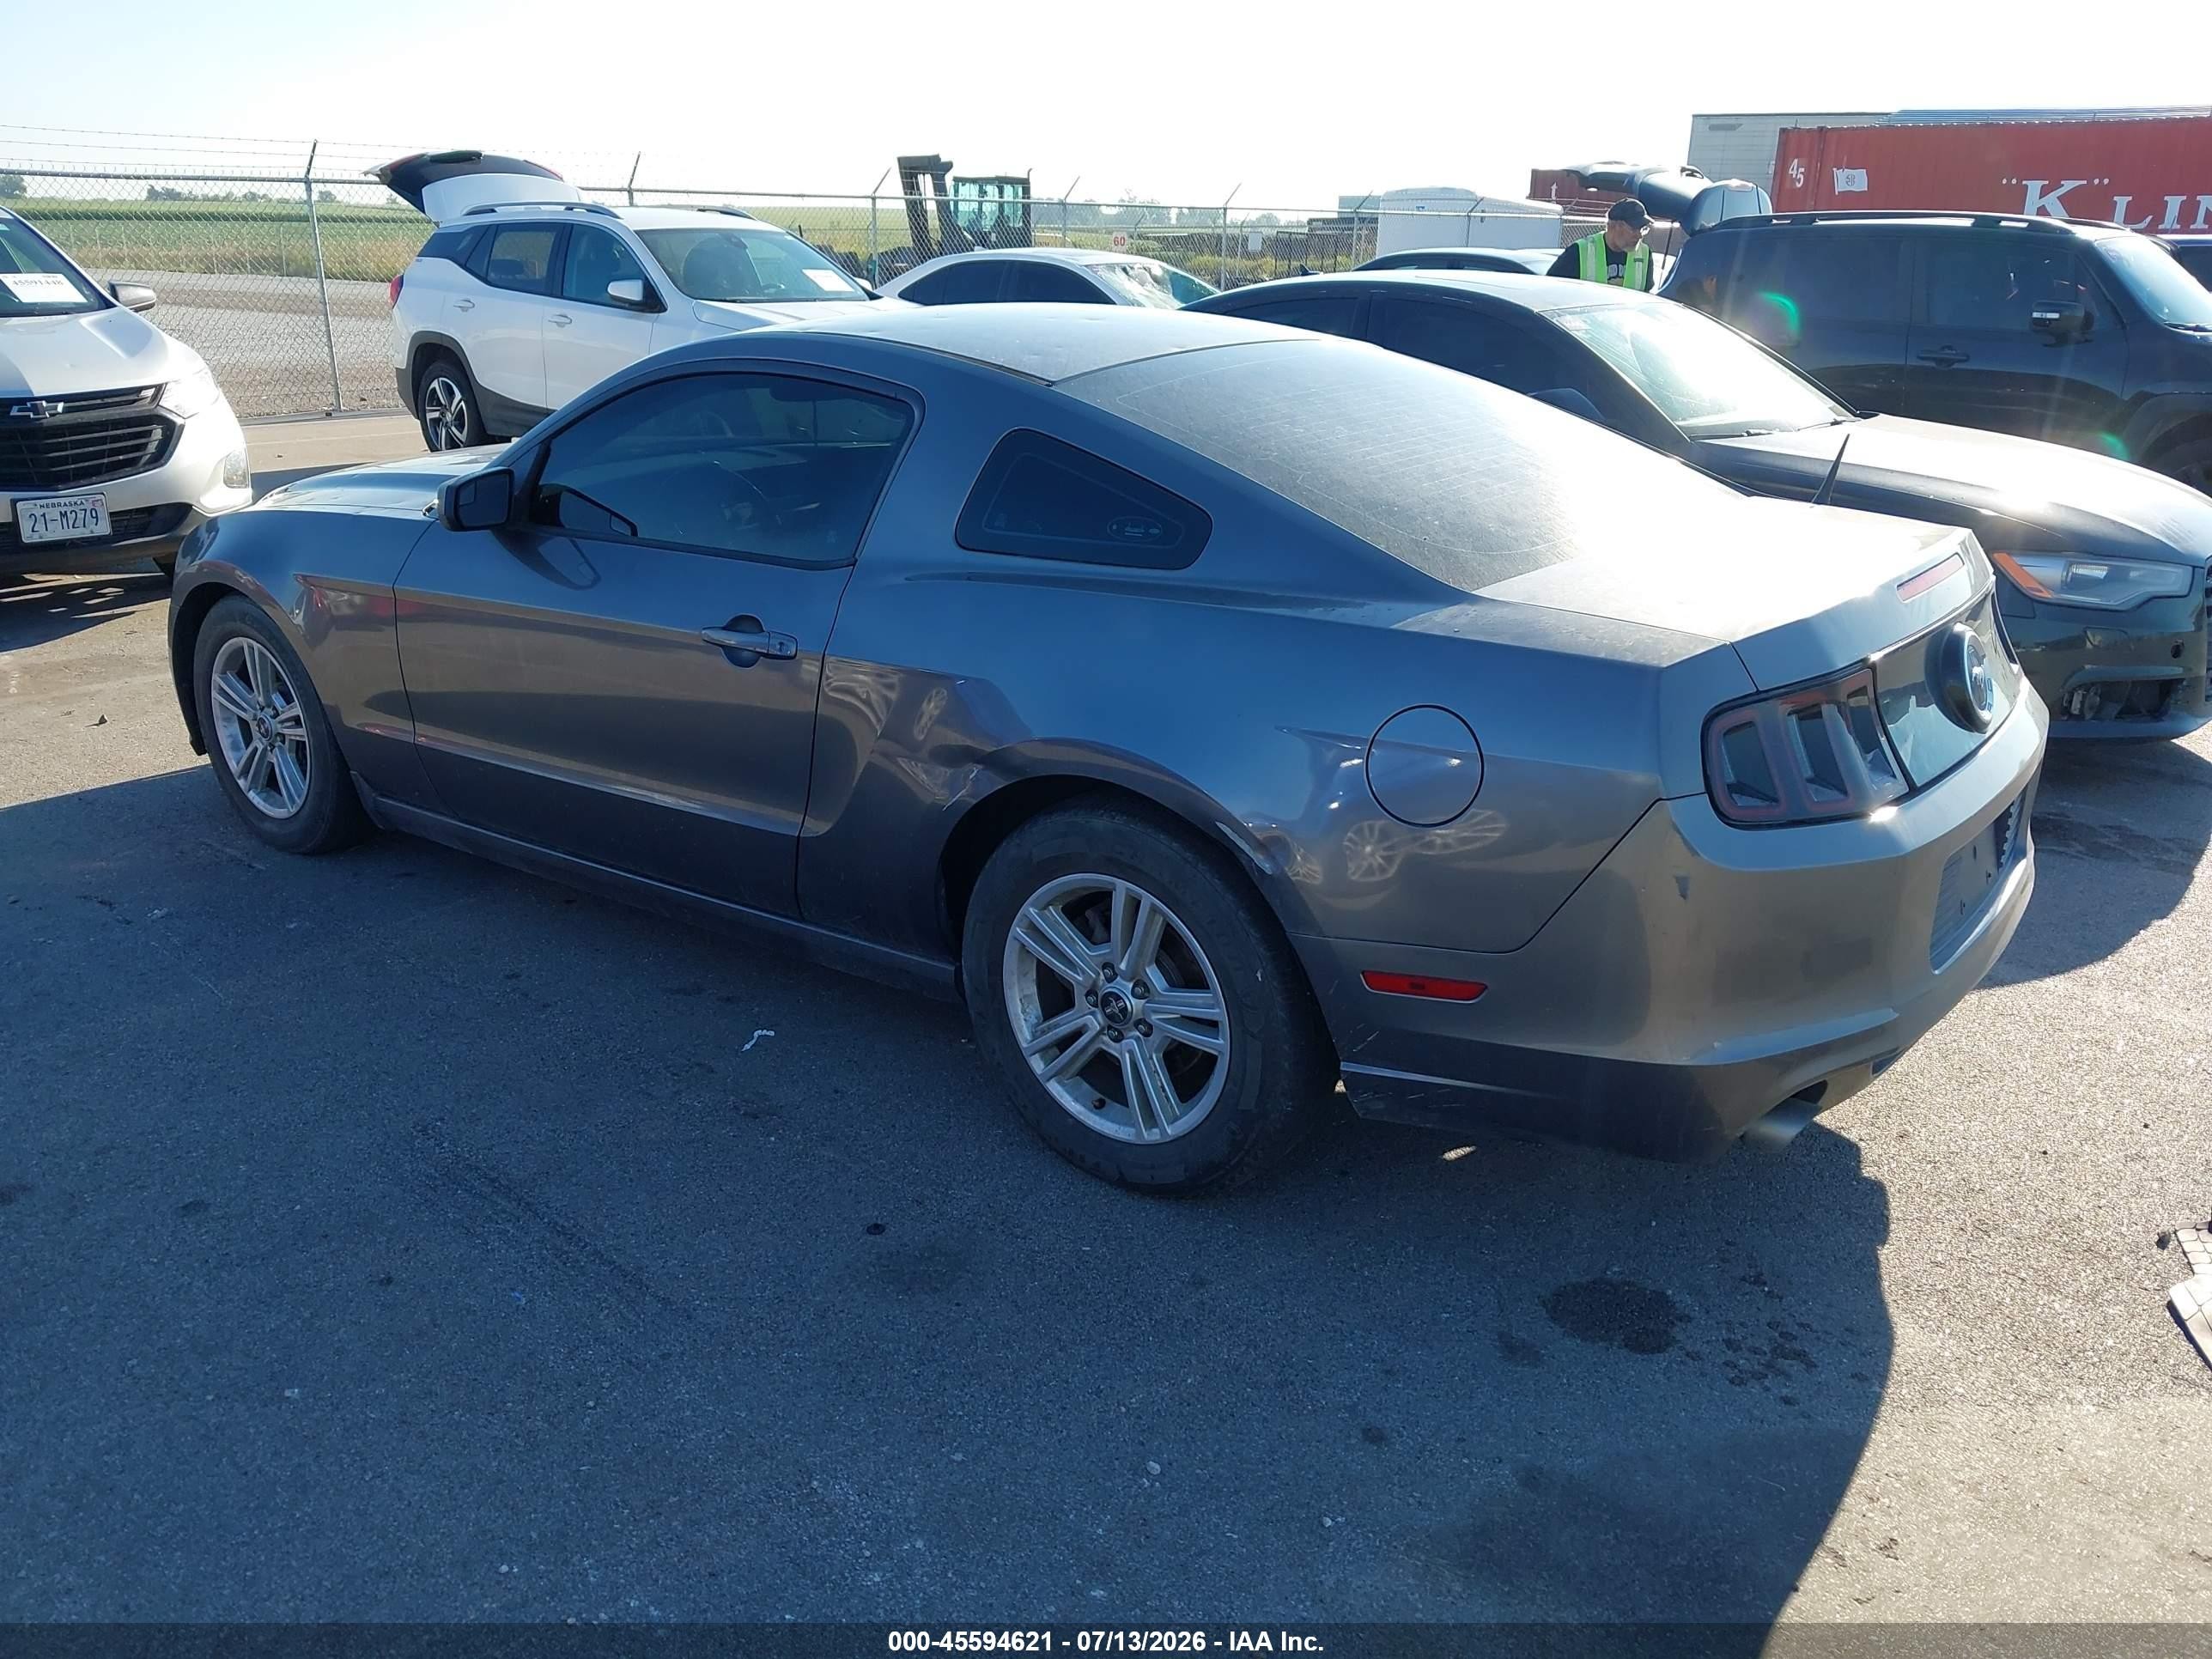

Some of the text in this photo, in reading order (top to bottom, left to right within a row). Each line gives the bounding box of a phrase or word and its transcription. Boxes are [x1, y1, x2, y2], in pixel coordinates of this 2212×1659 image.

[1789, 158, 1805, 188] 45
[1113, 236, 1126, 246] 60
[39, 500, 84, 508] NEBRASKA
[28, 507, 99, 532] 21-M279
